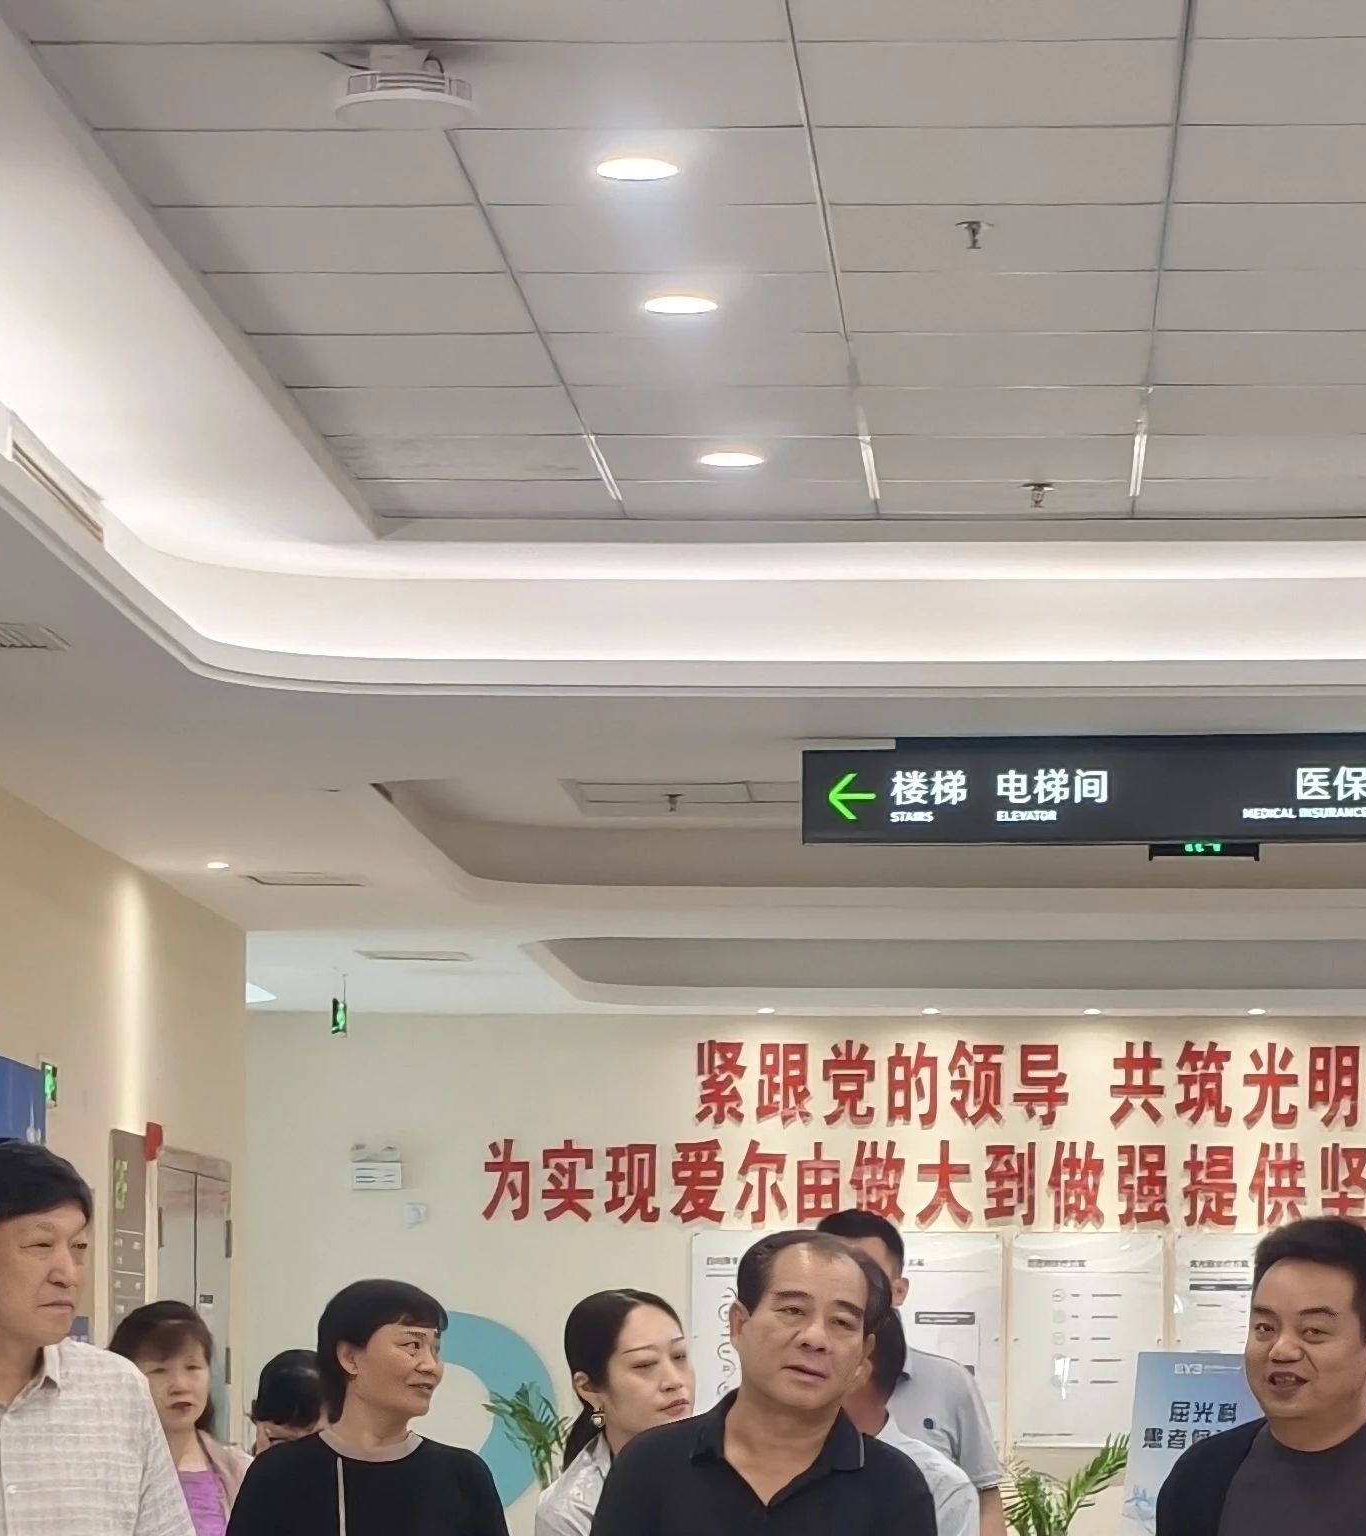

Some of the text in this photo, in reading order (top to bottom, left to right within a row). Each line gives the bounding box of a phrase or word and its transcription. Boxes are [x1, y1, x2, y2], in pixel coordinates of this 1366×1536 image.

[891, 769, 1108, 805] 楼梯 电梯间
[890, 811, 1057, 822] STAIRS ELEVATOR
[1242, 808, 1296, 819] MEDICAL
[696, 1039, 1069, 1127] 紧跟党的领导
